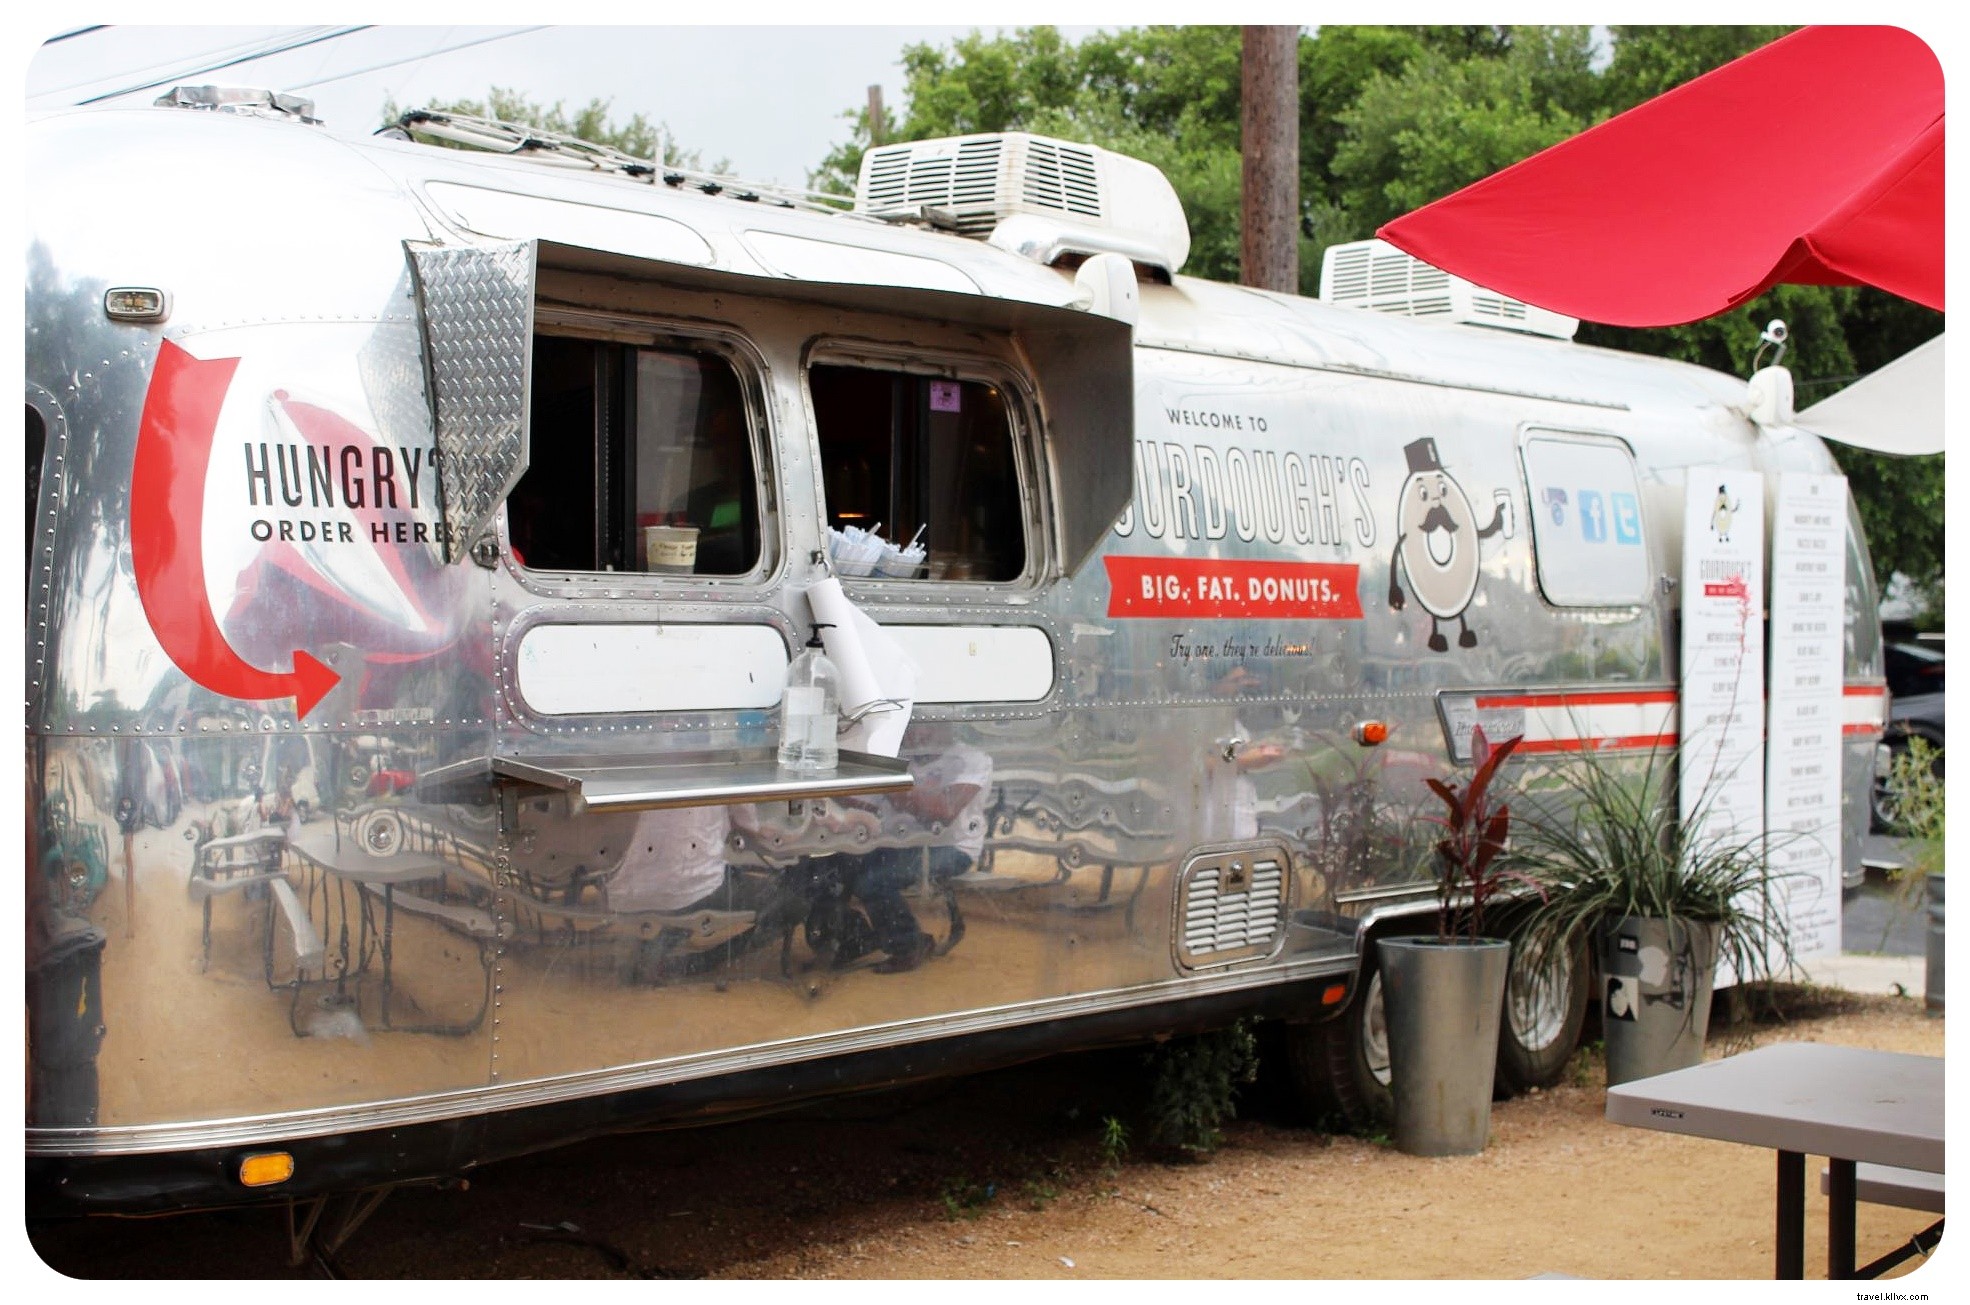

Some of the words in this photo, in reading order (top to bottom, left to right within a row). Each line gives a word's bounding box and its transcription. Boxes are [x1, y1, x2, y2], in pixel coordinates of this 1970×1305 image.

[1166, 408, 1242, 431] WELCOME
[1249, 416, 1268, 432] TO
[1114, 439, 1376, 548] URDOUGH'S
[250, 519, 354, 544] ORDER
[1141, 575, 1188, 600] BIG.
[1198, 576, 1240, 601] FAT.
[1249, 577, 1339, 602] DONUTS.
[1170, 633, 1191, 667] Try
